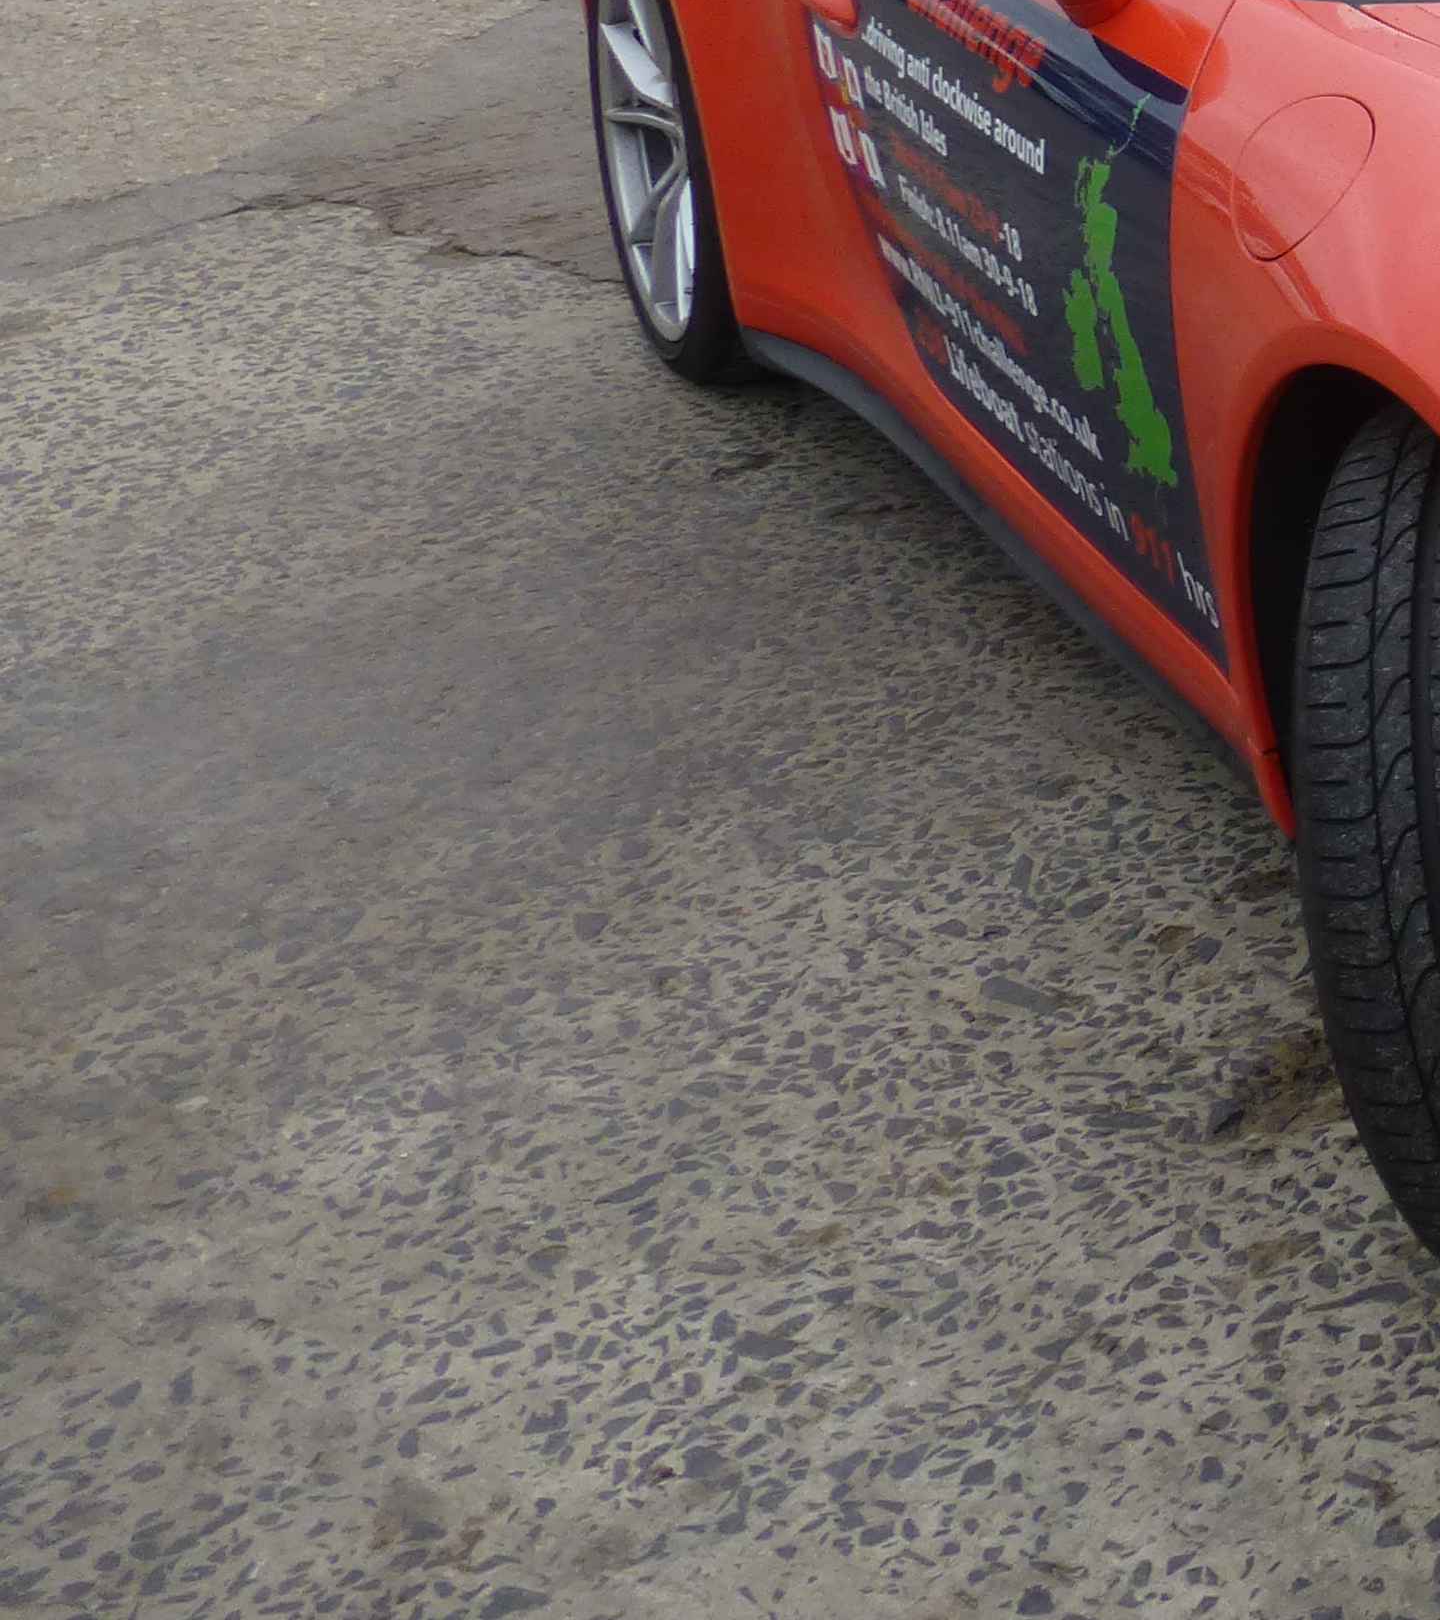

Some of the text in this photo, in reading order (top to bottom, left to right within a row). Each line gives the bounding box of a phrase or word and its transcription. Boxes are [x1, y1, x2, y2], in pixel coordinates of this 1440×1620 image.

[907, 54, 930, 91] anti
[932, 66, 991, 136] clockwise
[993, 115, 1045, 175] around
[920, 108, 947, 157] Isles
